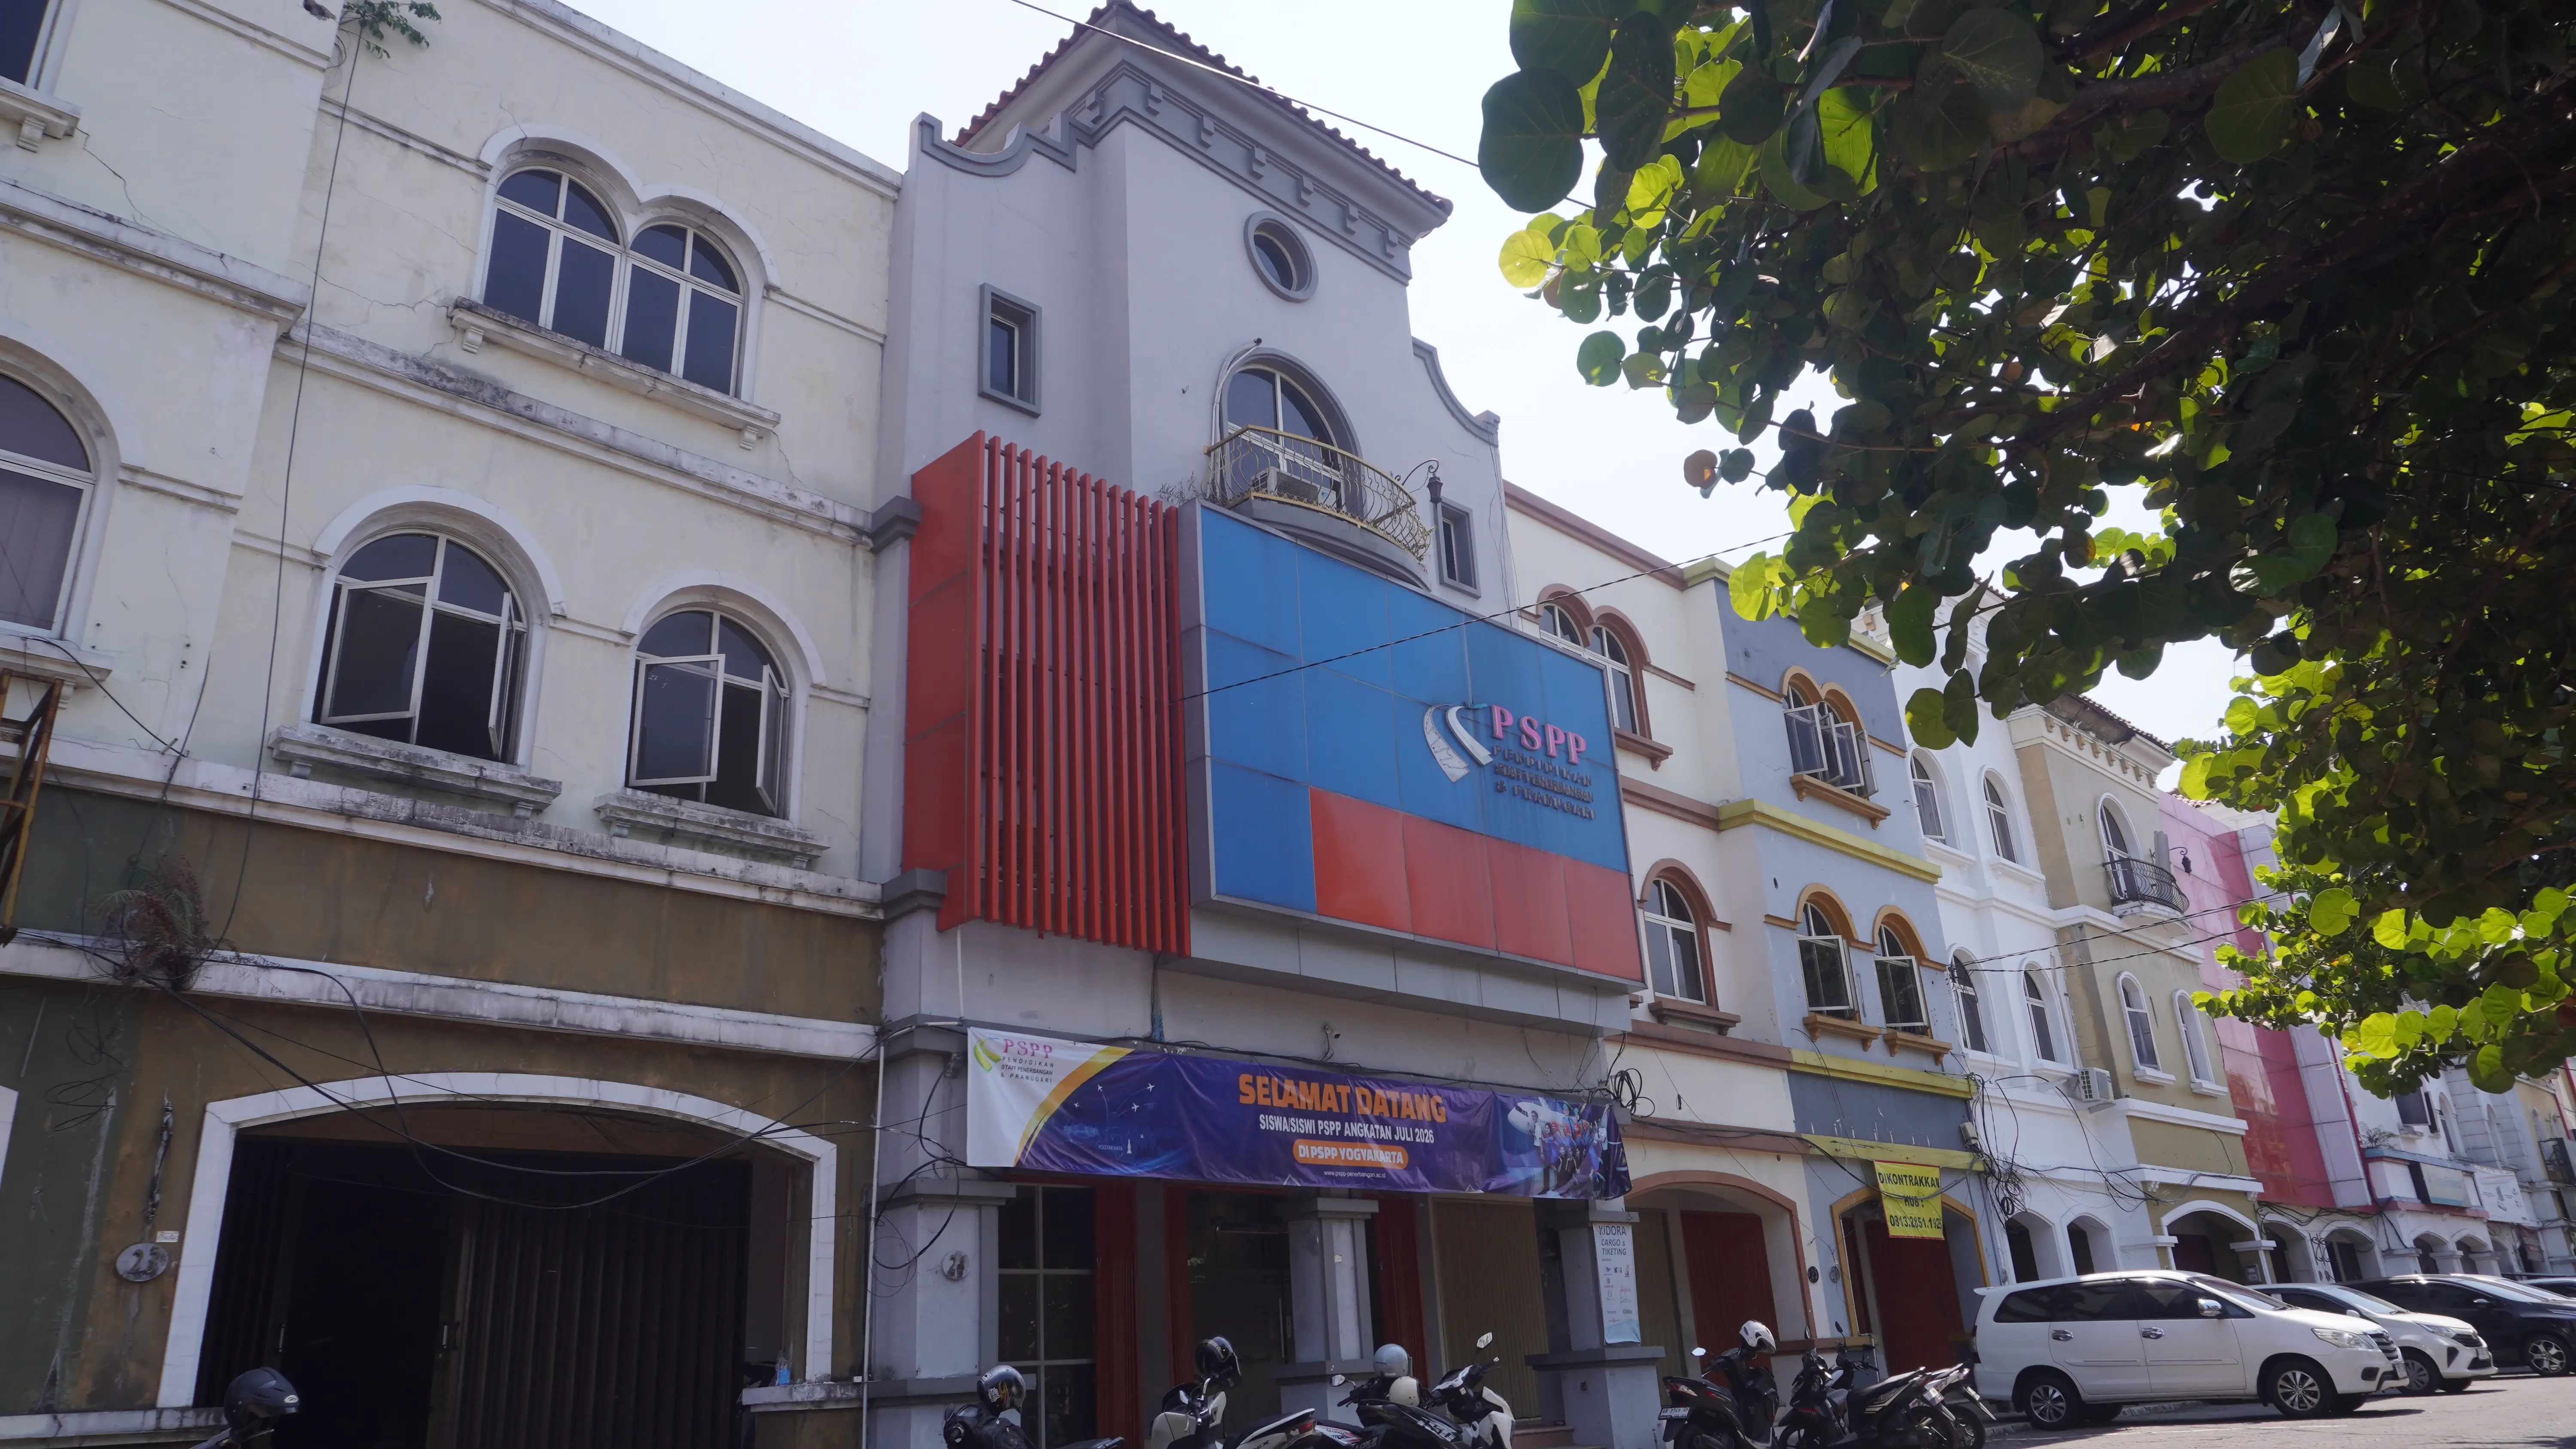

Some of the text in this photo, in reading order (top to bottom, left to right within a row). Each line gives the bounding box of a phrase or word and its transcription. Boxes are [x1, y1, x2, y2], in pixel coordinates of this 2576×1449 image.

[1491, 704, 1587, 765] PSPP
[1493, 745, 1592, 787] PENDIDIKAN
[1525, 772, 1594, 803] PENERBANGAN
[1497, 780, 1596, 821] & PRAMUGARI
[1003, 1039, 1052, 1059] PSPP
[1002, 1056, 1054, 1067] PENDIDIKAN
[1018, 1066, 1053, 1076] PENERBANGAN
[1010, 1073, 1052, 1083] PRAMUGARI
[1239, 1073, 1446, 1123] SELAMAT DATANG
[1259, 1114, 1435, 1144] SISWA/SISWI PSPP ANGKATAN JULI 2026
[1298, 1145, 1404, 1164] DI PSPP YOGYAKARTA
[1324, 1170, 1386, 1178] www.pspp-penerbangan.ac.id
[1877, 1172, 1940, 1188] DIKONTRAKKAN
[1904, 1195, 1919, 1207] HUB
[1598, 1225, 1627, 1236] KIDORA
[128, 1246, 161, 1274] 23
